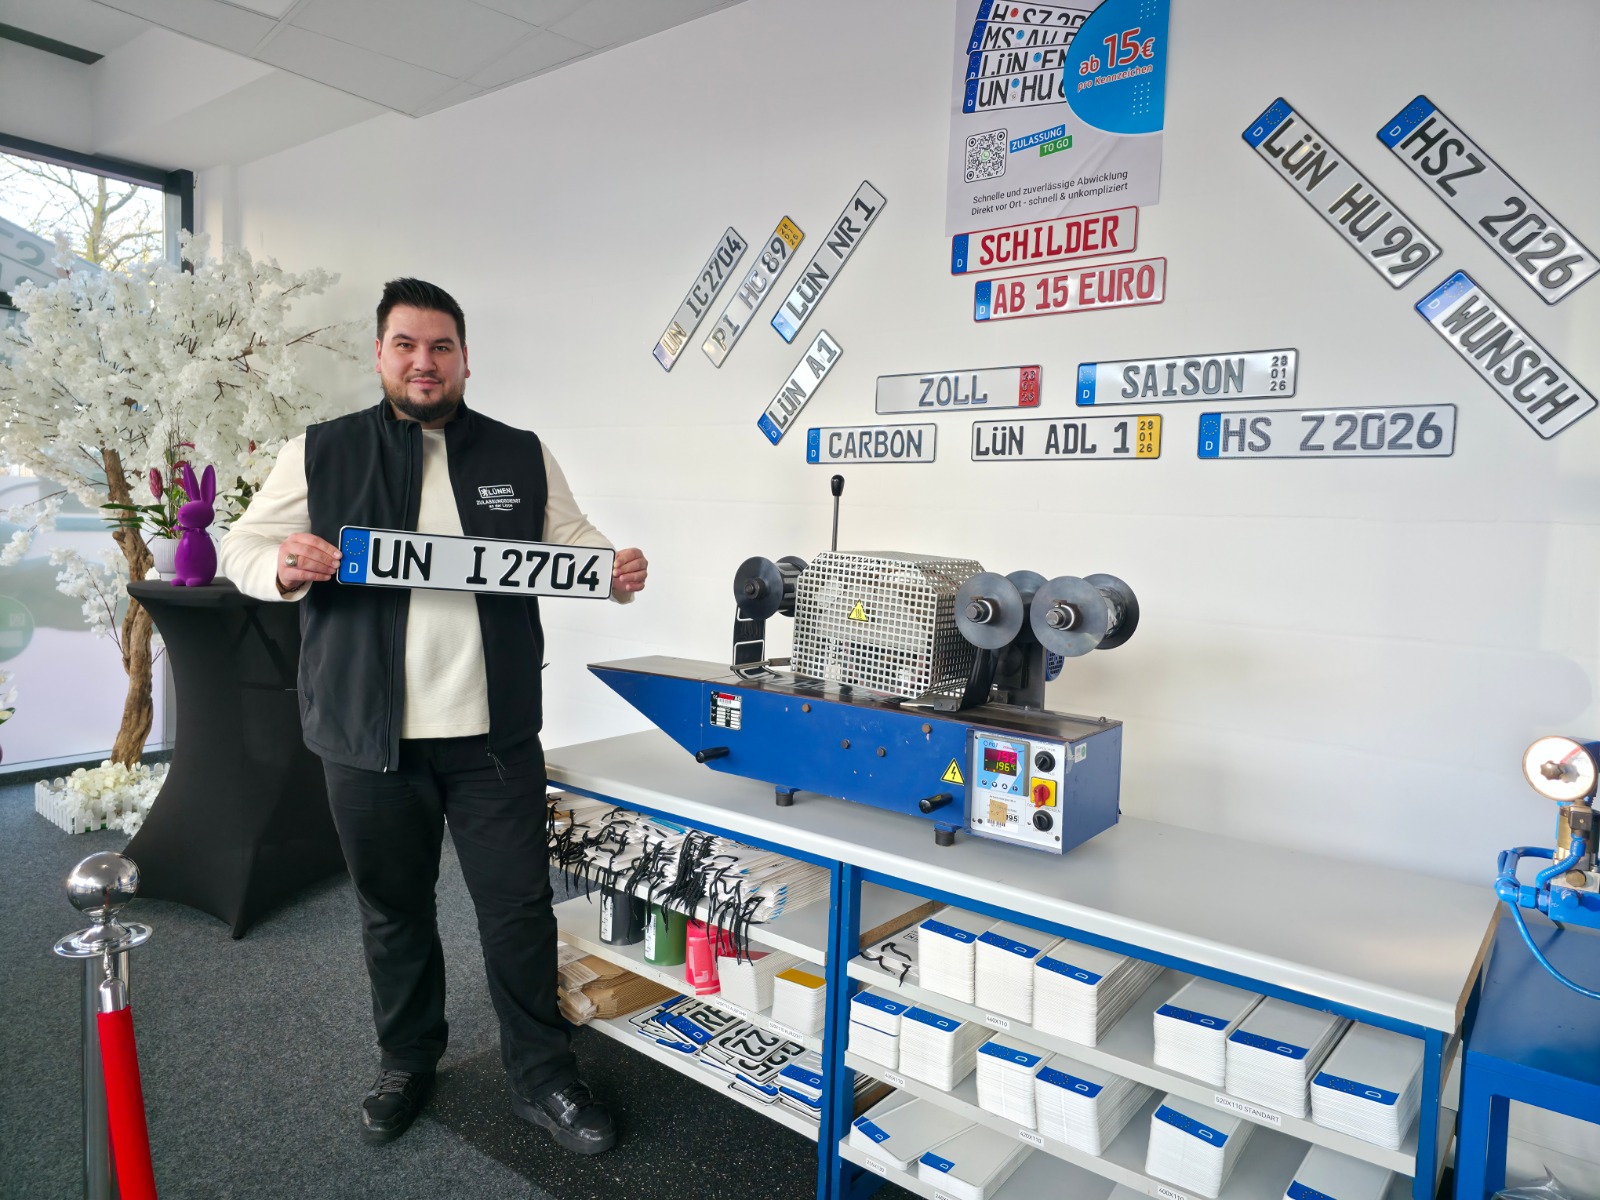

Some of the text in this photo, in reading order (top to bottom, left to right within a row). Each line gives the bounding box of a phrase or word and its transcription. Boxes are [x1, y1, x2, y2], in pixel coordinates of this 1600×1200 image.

[1077, 79, 1093, 92] pro
[1094, 64, 1153, 86] Kennzeichen
[1079, 54, 1100, 75] ab
[979, 78, 1010, 107] UN
[1020, 73, 1054, 102] HU
[1012, 126, 1063, 150] ZULASSUNG
[1043, 138, 1069, 153] TO GO
[971, 205, 994, 215] Direkt
[995, 203, 1008, 211] vor
[1009, 199, 1022, 209] Ort
[1028, 193, 1058, 206] schnell
[1059, 192, 1066, 200] &
[1068, 182, 1128, 200] unkompliziert
[973, 171, 1128, 203] Schnelle und zuverlässige Abwicklung
[1253, 126, 1263, 137] D
[1327, 182, 1393, 243] HU
[1371, 225, 1430, 275] 99
[1390, 117, 1584, 289] D HSZ 2026
[827, 216, 861, 259] NR
[854, 197, 875, 222] 1
[957, 215, 1119, 267] D SCHILDER
[761, 237, 787, 274] 89
[979, 264, 1155, 315] D AB 15 EURO
[662, 321, 686, 356] UN
[1271, 355, 1288, 367] 28
[1271, 368, 1286, 379] 01
[1427, 294, 1580, 425] D WUNSCH
[918, 375, 988, 407] ZOLL
[1082, 358, 1245, 399] D SAISON
[1270, 380, 1287, 392] 26
[770, 430, 777, 438] D
[1045, 422, 1097, 455] ADL
[1113, 421, 1130, 454] 1
[1139, 420, 1153, 430] 28
[1139, 432, 1153, 442] 01
[1205, 440, 1214, 451] D
[1222, 416, 1272, 452] HS
[811, 429, 922, 459] D CARBON
[1139, 443, 1153, 453] 26
[489, 487, 511, 496] LÜNEN
[349, 562, 359, 574] D
[371, 537, 432, 582] UN
[499, 548, 600, 592] 2704
[996, 761, 1010, 772] 196
[1215, 1096, 1280, 1123] 520X110 STANDART
